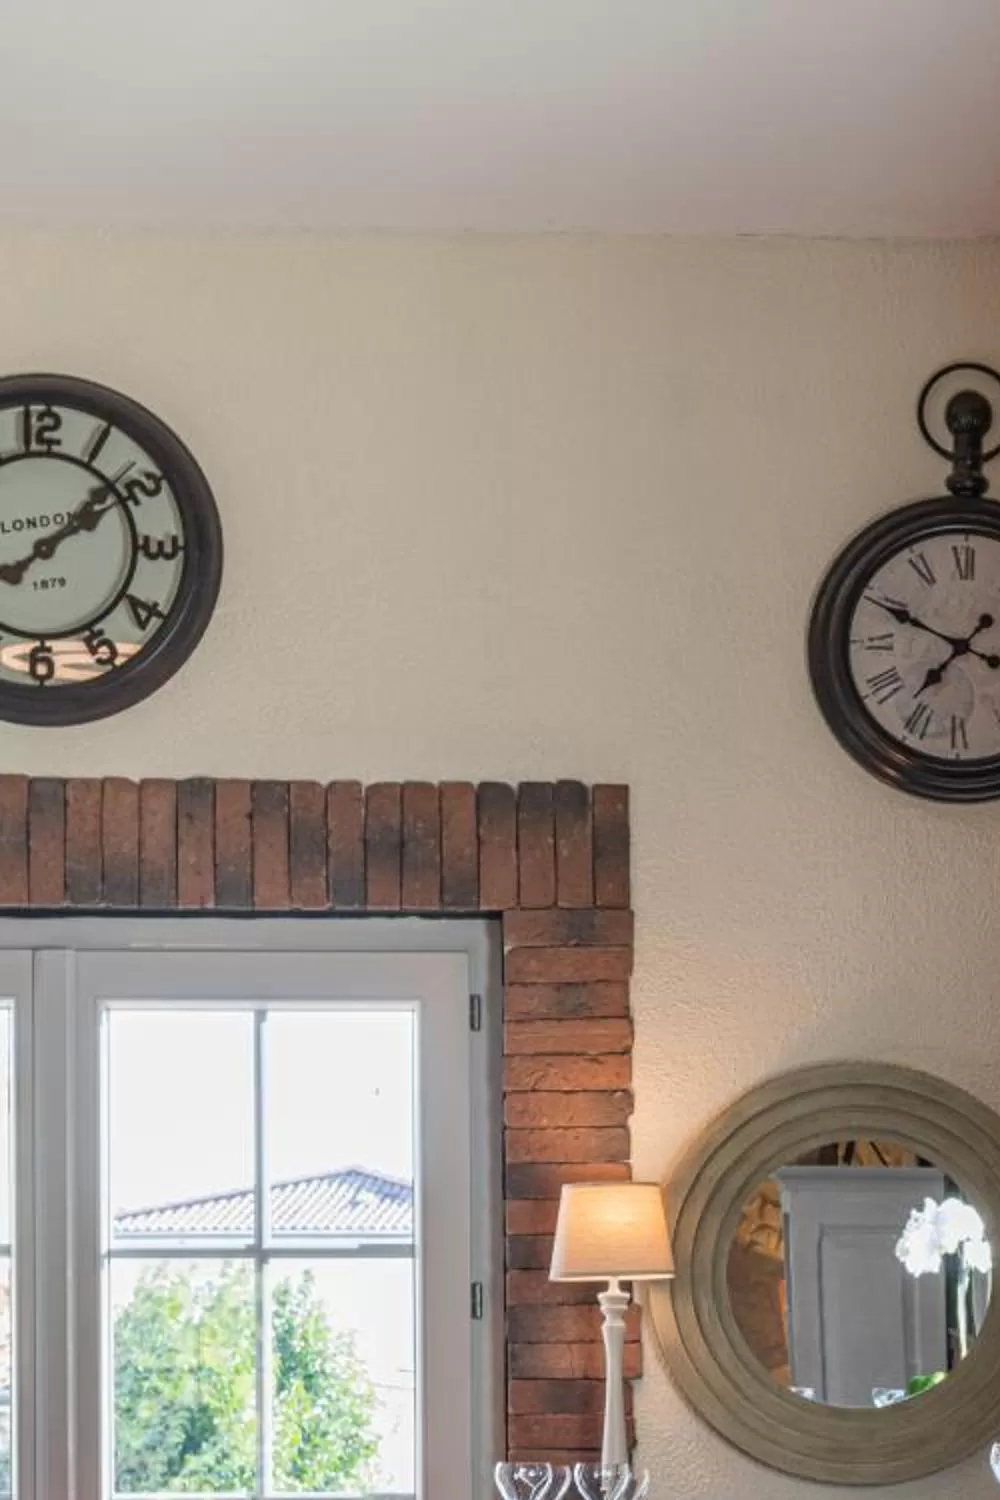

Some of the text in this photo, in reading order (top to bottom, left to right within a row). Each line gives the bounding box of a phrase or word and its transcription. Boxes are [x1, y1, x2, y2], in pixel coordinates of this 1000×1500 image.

[125, 471, 163, 506] 2
[139, 534, 180, 561] 3
[126, 593, 167, 631] 4
[29, 643, 55, 683] 6
[83, 627, 119, 668] 5
